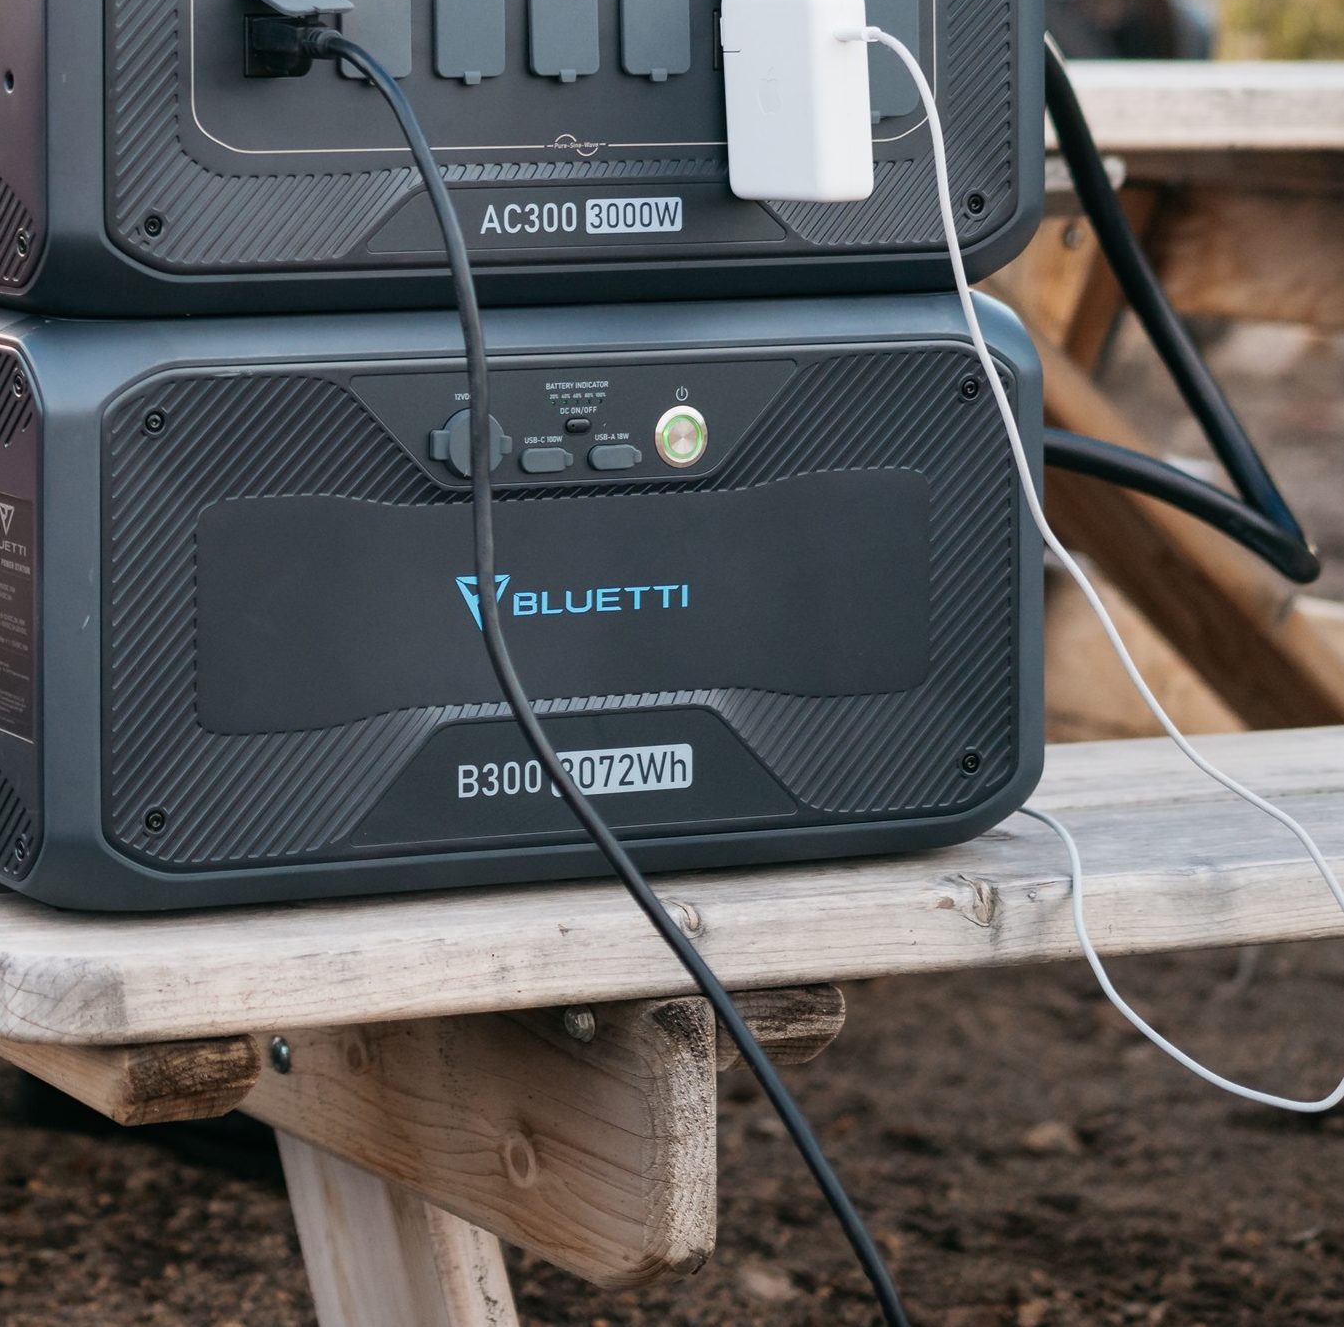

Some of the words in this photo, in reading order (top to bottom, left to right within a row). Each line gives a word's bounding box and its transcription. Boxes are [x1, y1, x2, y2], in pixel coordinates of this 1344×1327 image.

[480, 202, 578, 234] AC300
[590, 201, 679, 229] 3000W
[546, 382, 574, 390] BATTERY
[575, 380, 609, 389] INDICATOR
[570, 406, 597, 414] ON/OFF
[524, 436, 545, 444] USB-C
[594, 433, 616, 441] USB-A
[616, 432, 630, 440] 18W
[513, 584, 689, 616] BLUETTI
[458, 760, 542, 798] B300
